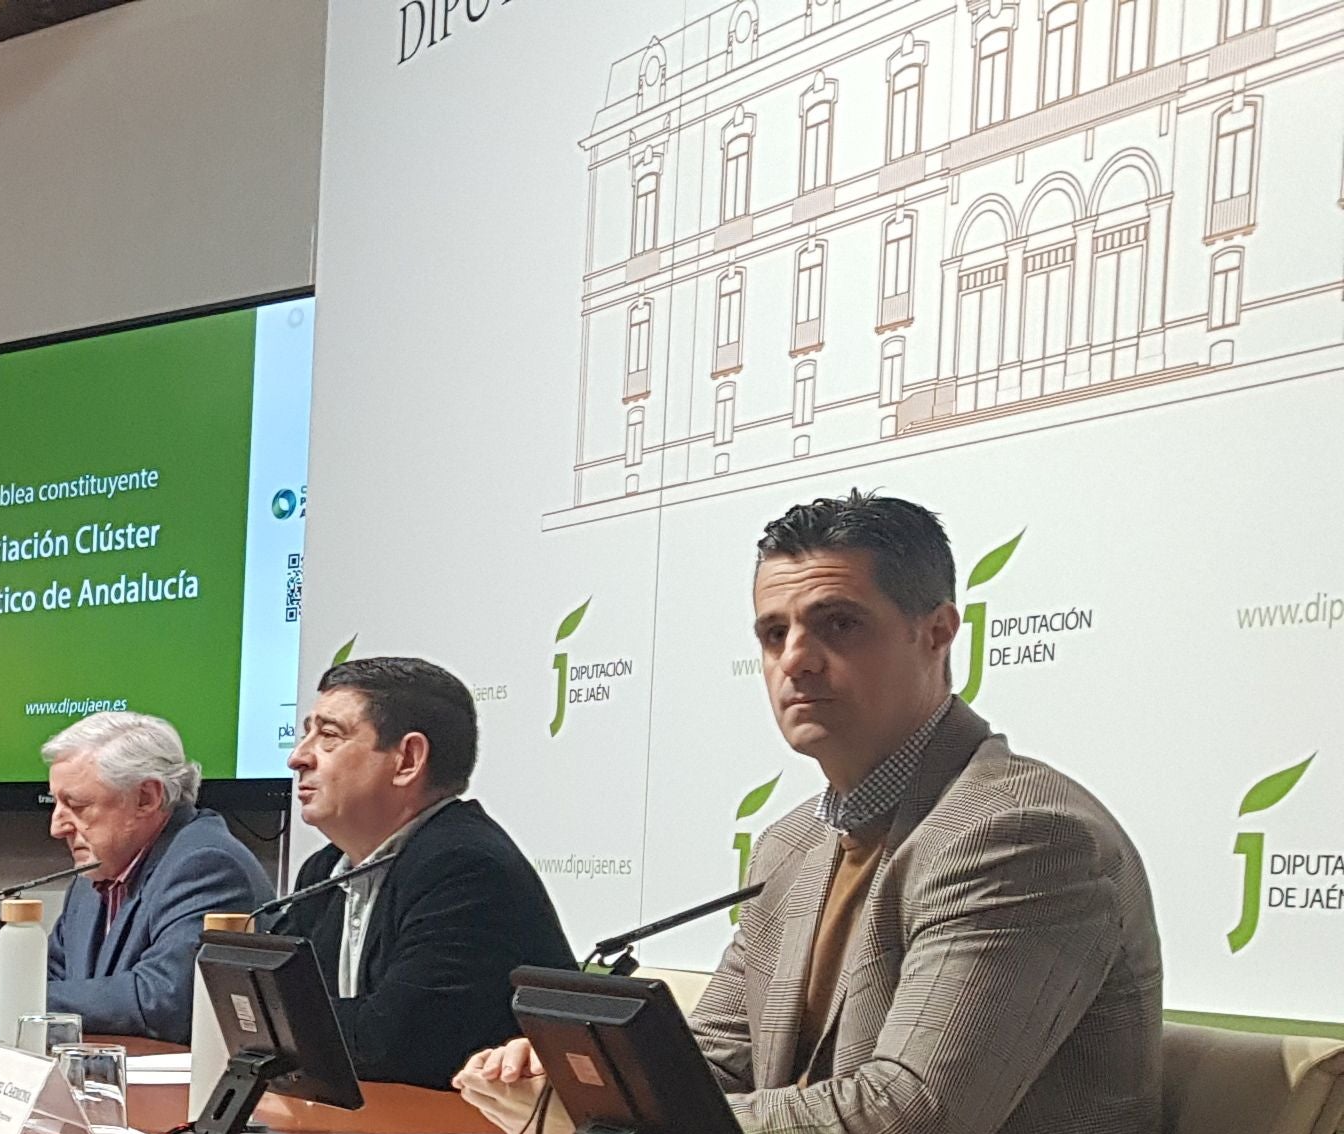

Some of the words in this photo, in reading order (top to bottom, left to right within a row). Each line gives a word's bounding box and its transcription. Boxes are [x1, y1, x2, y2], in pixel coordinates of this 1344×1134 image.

[38, 468, 160, 499] constituyente
[74, 522, 161, 554] Clúster
[42, 580, 72, 610] de
[76, 568, 200, 608] Andalucía
[991, 606, 1093, 638] DIPUTACIÓN
[989, 646, 1012, 667] DE
[1012, 639, 1056, 665] JAÉN
[569, 659, 633, 682] DIPUTACIÓN
[25, 697, 127, 717] www.dipujaen.es
[568, 688, 583, 704] DE
[583, 684, 611, 703] JAÉN
[533, 853, 632, 880] www.dipujaen.es
[1267, 886, 1298, 908] DE
